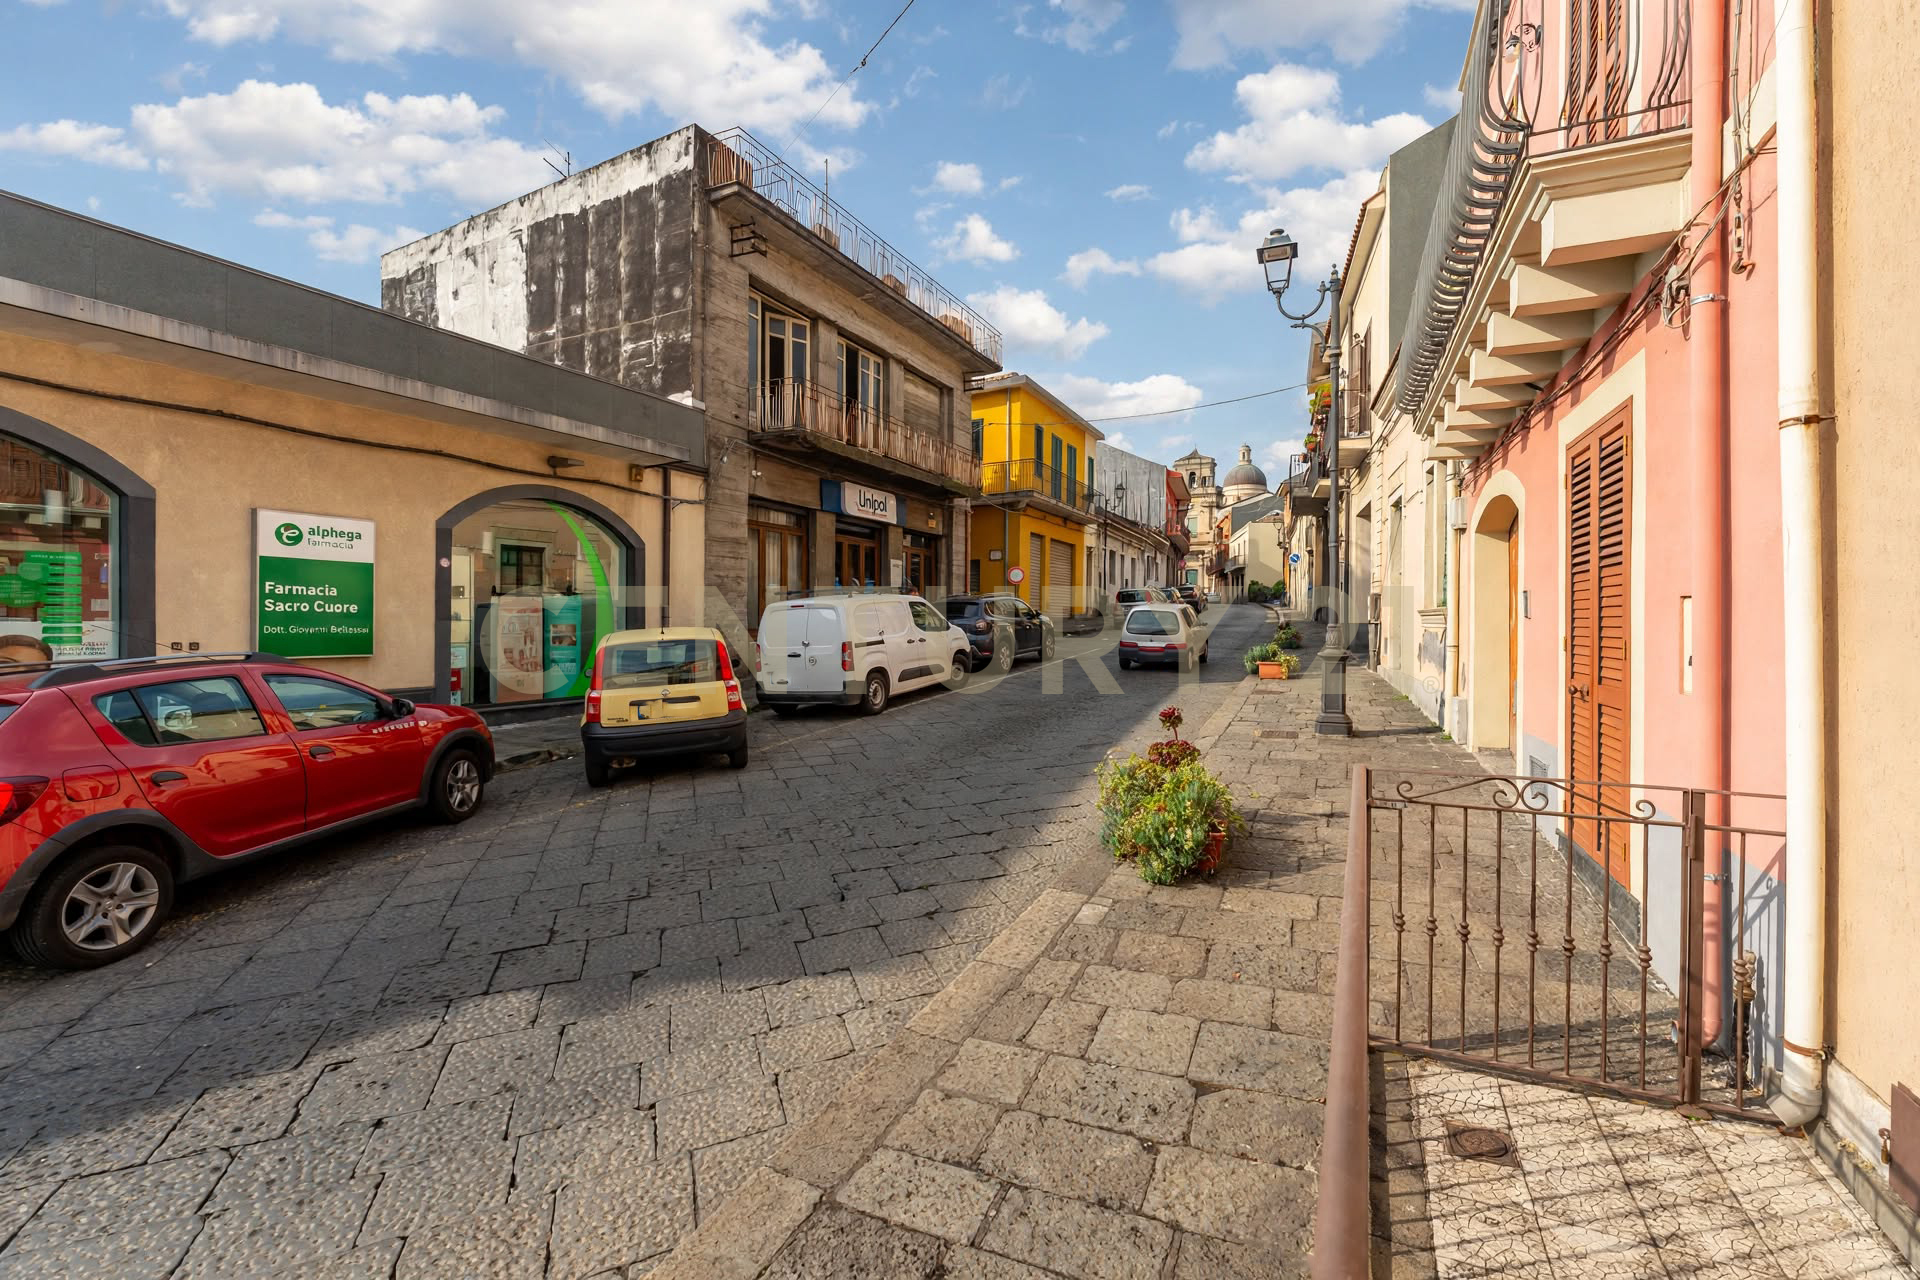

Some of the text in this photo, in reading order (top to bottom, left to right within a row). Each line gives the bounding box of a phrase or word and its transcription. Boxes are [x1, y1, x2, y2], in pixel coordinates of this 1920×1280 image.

[858, 489, 887, 515] Unipol
[308, 526, 362, 541] alphega
[308, 539, 354, 550] farmacia
[264, 581, 338, 597] Farmacia
[264, 599, 359, 614] Sacro Cuore
[263, 625, 287, 634] Dott.
